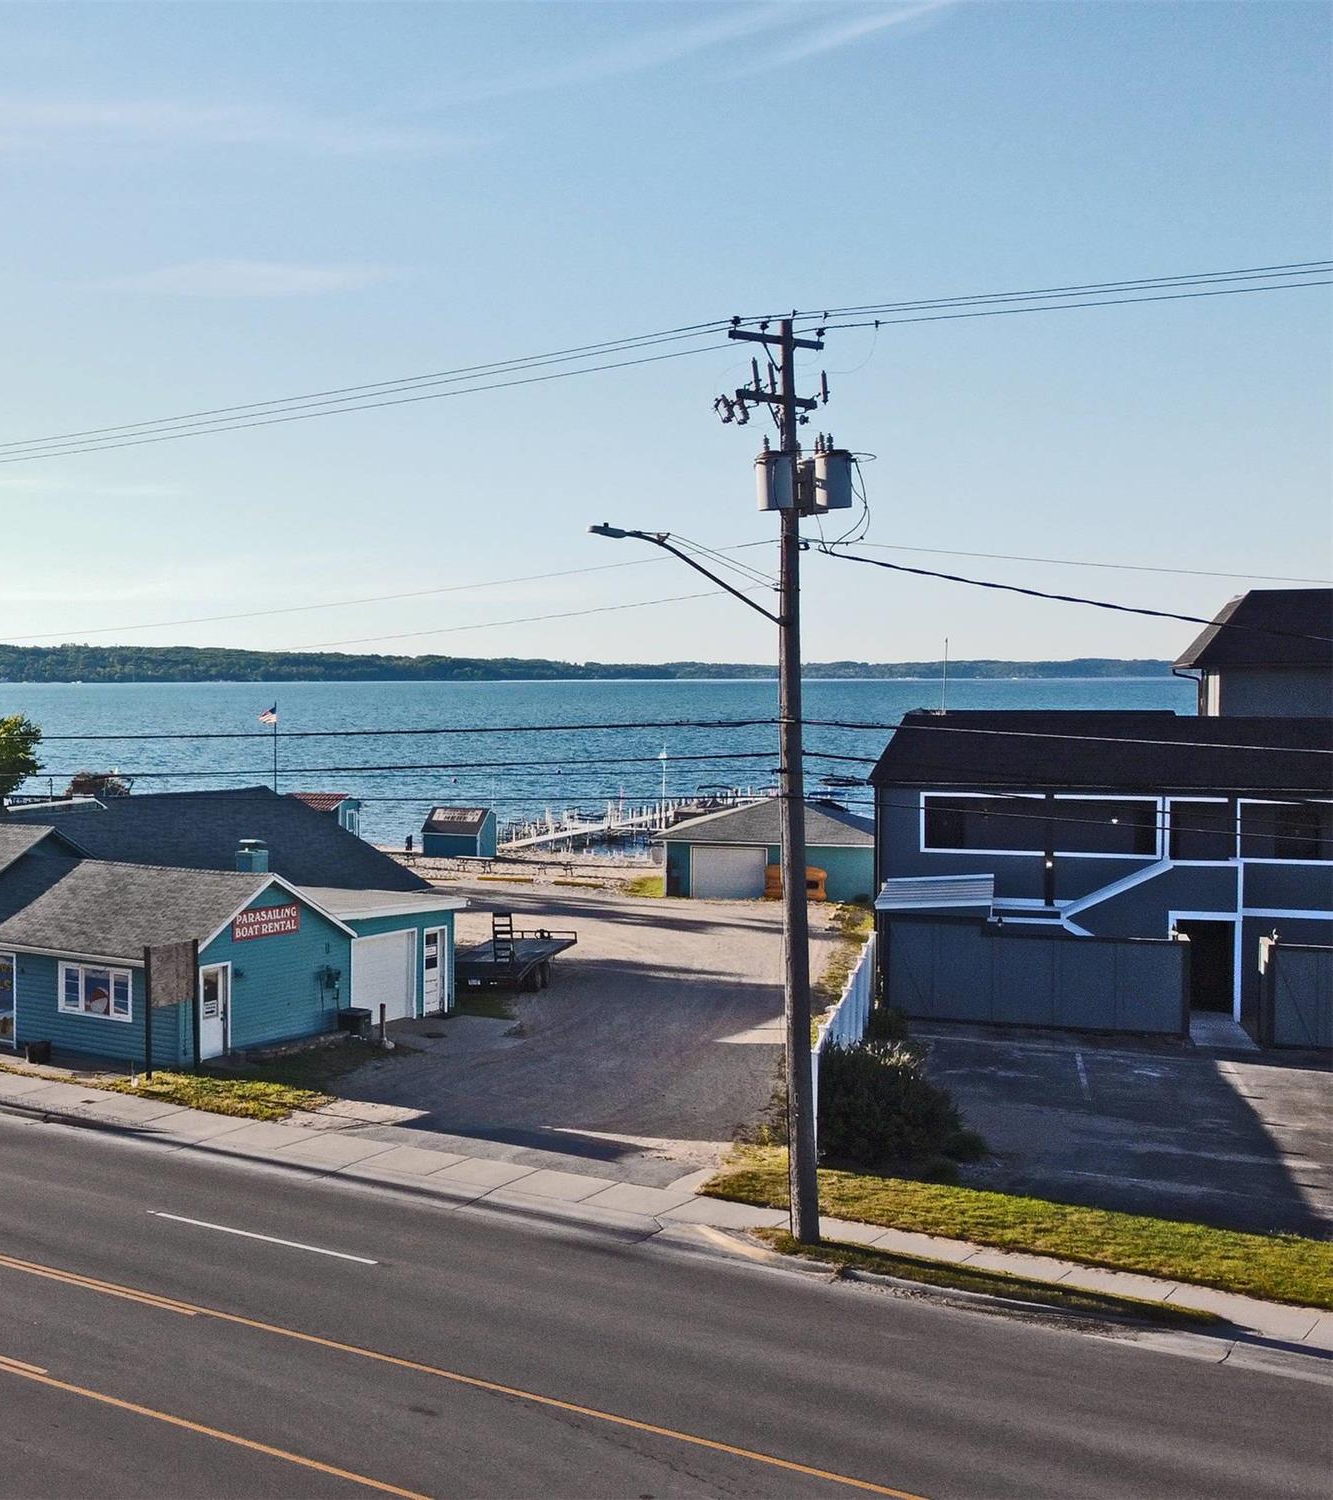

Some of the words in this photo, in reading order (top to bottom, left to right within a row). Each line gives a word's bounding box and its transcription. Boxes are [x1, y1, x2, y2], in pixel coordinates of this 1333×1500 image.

[235, 906, 297, 925] PARASAILING
[235, 924, 260, 938] BOAT
[261, 919, 297, 934] RENTAL
